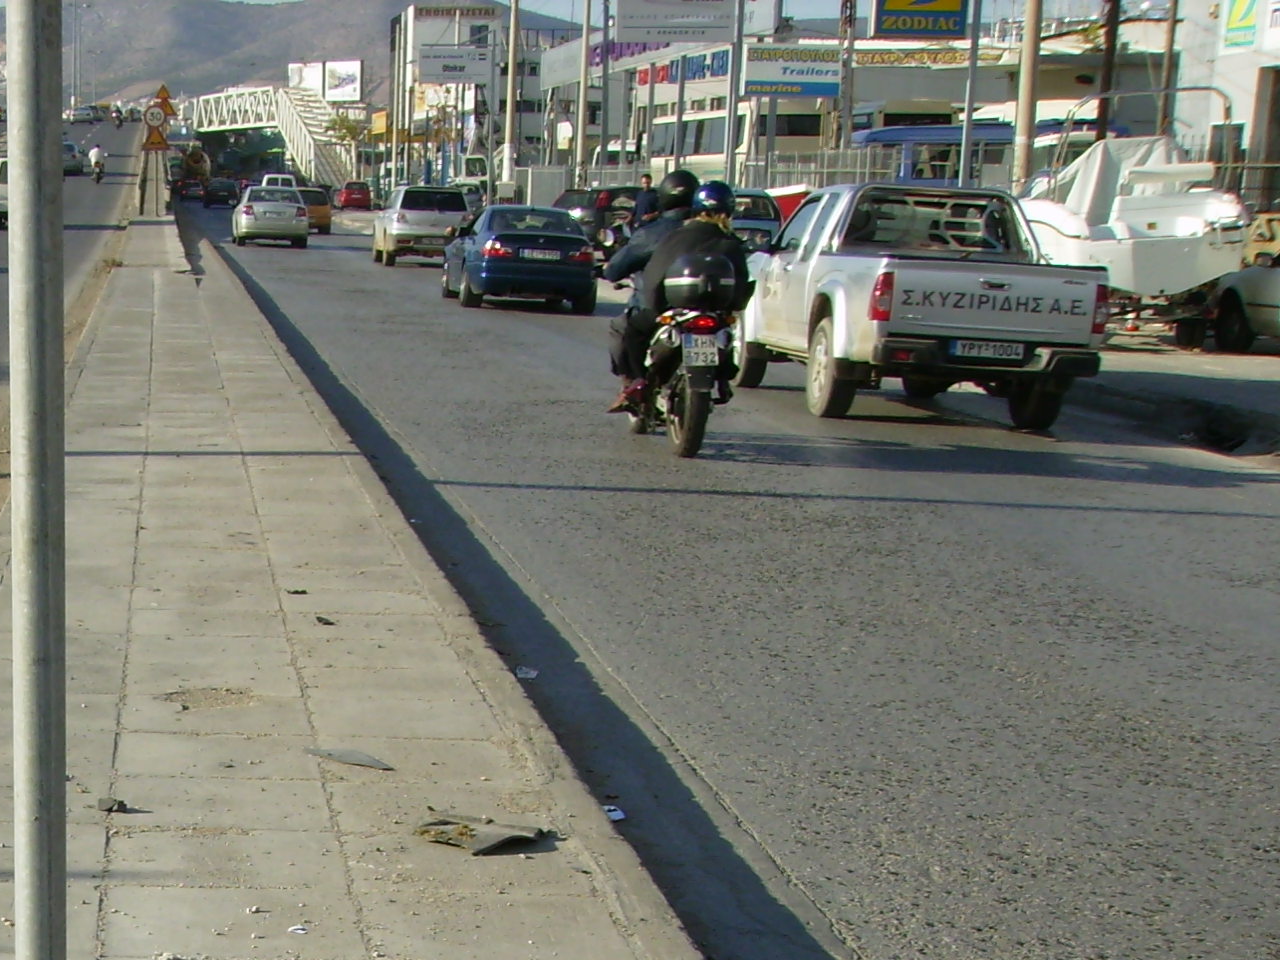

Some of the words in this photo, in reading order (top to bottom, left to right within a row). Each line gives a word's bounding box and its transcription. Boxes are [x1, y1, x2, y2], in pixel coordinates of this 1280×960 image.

[881, 15, 961, 31] ZODIAC
[747, 48, 841, 62] ΣΤΑΥΡΟΠΟΥΛΟΣ
[781, 67, 840, 77] Trailers
[746, 84, 802, 93] marine
[149, 111, 162, 122] 30
[901, 289, 1044, 314] Σ.ΚΥΖΙΡΙΔΗΣ
[1048, 298, 1088, 317] Α.Ε.
[693, 352, 717, 364] 732
